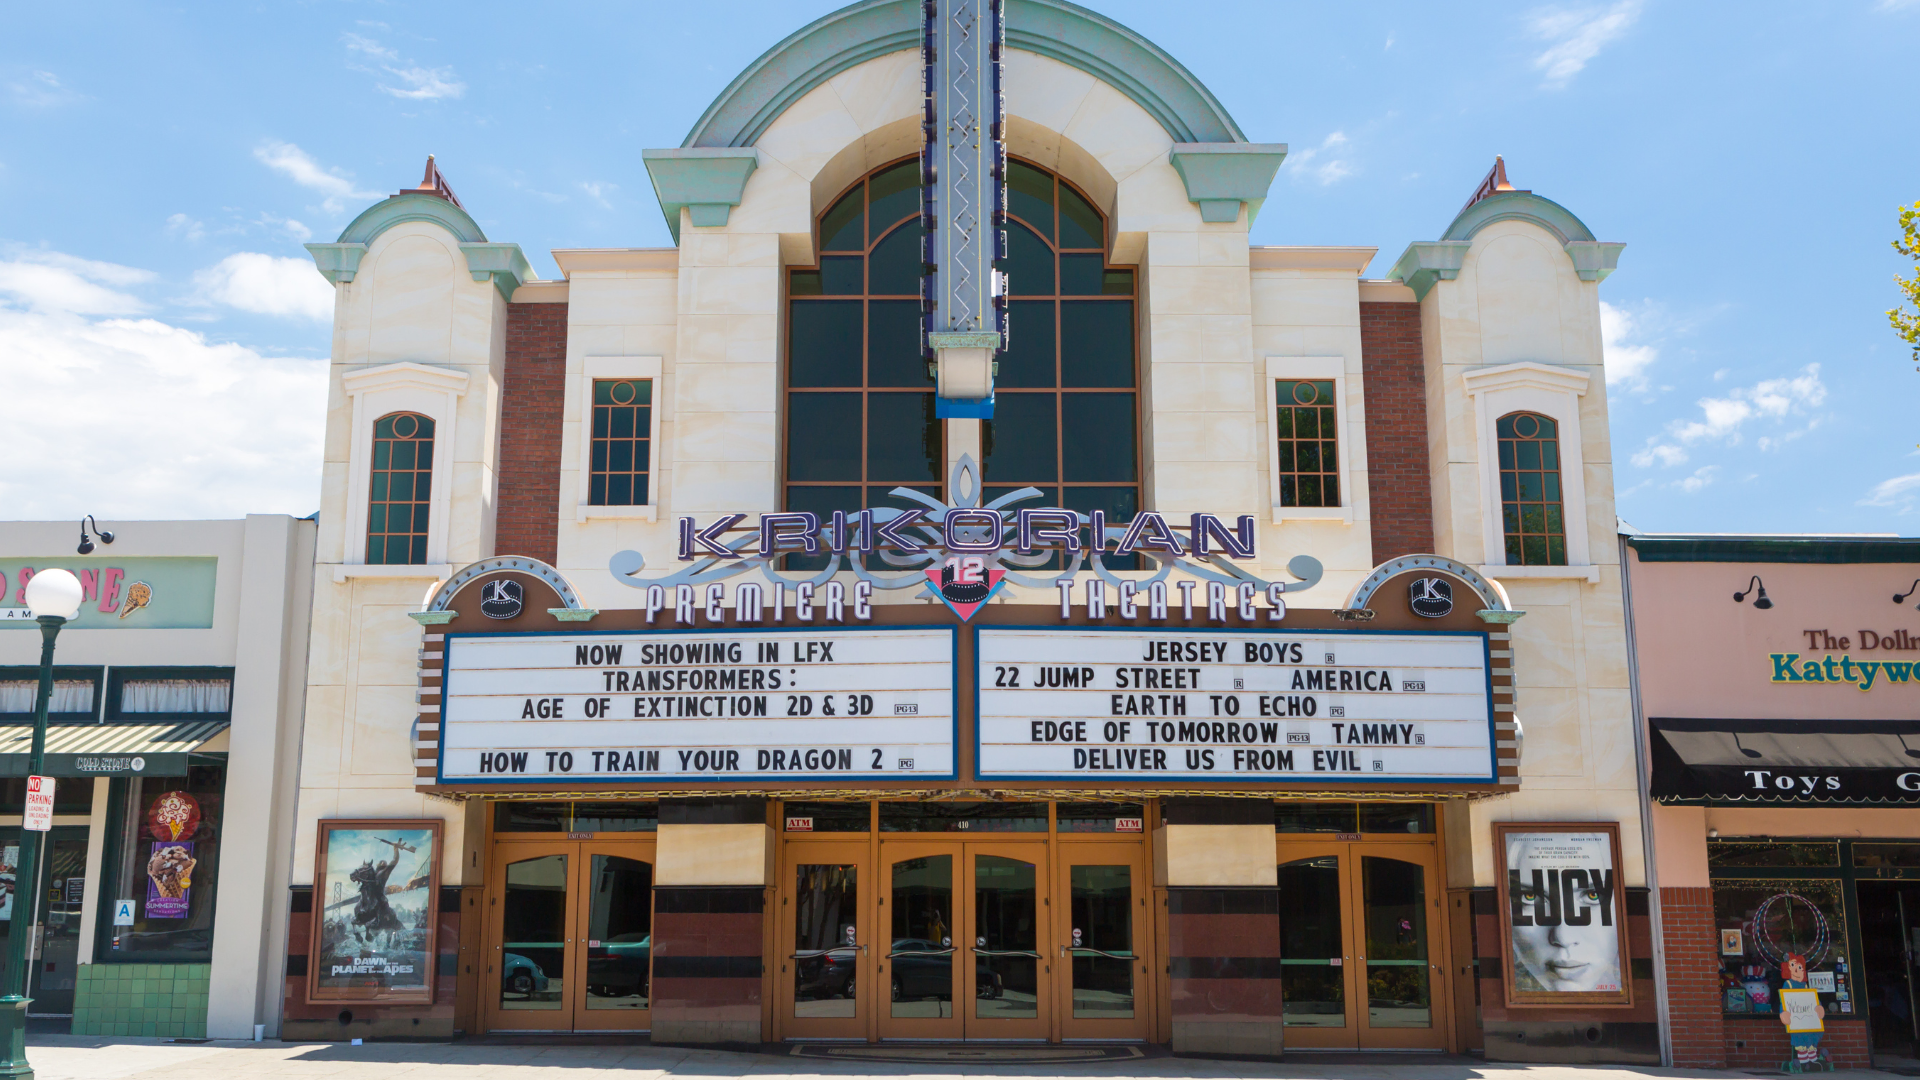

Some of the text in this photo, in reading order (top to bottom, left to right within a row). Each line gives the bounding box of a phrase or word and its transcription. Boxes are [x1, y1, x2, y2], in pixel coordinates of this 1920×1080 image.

[678, 508, 1256, 561] KRIKORIAN
[944, 557, 985, 582] 12
[16, 567, 125, 613] SNE
[1056, 579, 1286, 623] THEATRES
[646, 580, 872, 626] PREMIERE
[1803, 629, 1850, 650] The
[575, 642, 834, 665] NOW SHOWING IN LFX
[1143, 641, 1227, 663] JERSEY
[1244, 642, 1303, 663] BOYS
[995, 666, 1020, 688] 22
[1033, 667, 1095, 688] JUMP
[1115, 667, 1201, 689] STREET
[1291, 669, 1393, 692] AMERICA
[521, 698, 563, 719] AGE
[584, 698, 610, 718] OF
[634, 696, 767, 718] EXTINCTION
[787, 695, 812, 716] 2D
[822, 695, 836, 716] &
[847, 694, 874, 715] 3D
[1111, 694, 1343, 717] EARTH TO ECHO PG
[1031, 720, 1087, 742] EDGE
[1103, 721, 1131, 742] OF
[1146, 721, 1279, 743] TOMORROW
[1331, 723, 1414, 744] TAMMY
[75, 757, 100, 769] COLD
[100, 757, 131, 769] STONE
[479, 748, 912, 773] HOW TO TRAIN YOUR DRAGON 2 PG
[1073, 748, 1168, 770] DELIVER
[1185, 749, 1215, 770] US
[1233, 749, 1294, 771] FROM
[1312, 750, 1361, 771] EVIL
[28, 778, 40, 791] NO
[1744, 770, 1841, 795] Toys
[28, 793, 52, 806] PARKING
[788, 819, 810, 827] ATM
[957, 820, 969, 829] 410
[1117, 819, 1140, 828] ATM
[1509, 869, 1614, 926] LUCY
[118, 903, 130, 917] A
[331, 965, 375, 977] PLANET
[383, 965, 414, 976] APES
[354, 957, 387, 966] DAWN
